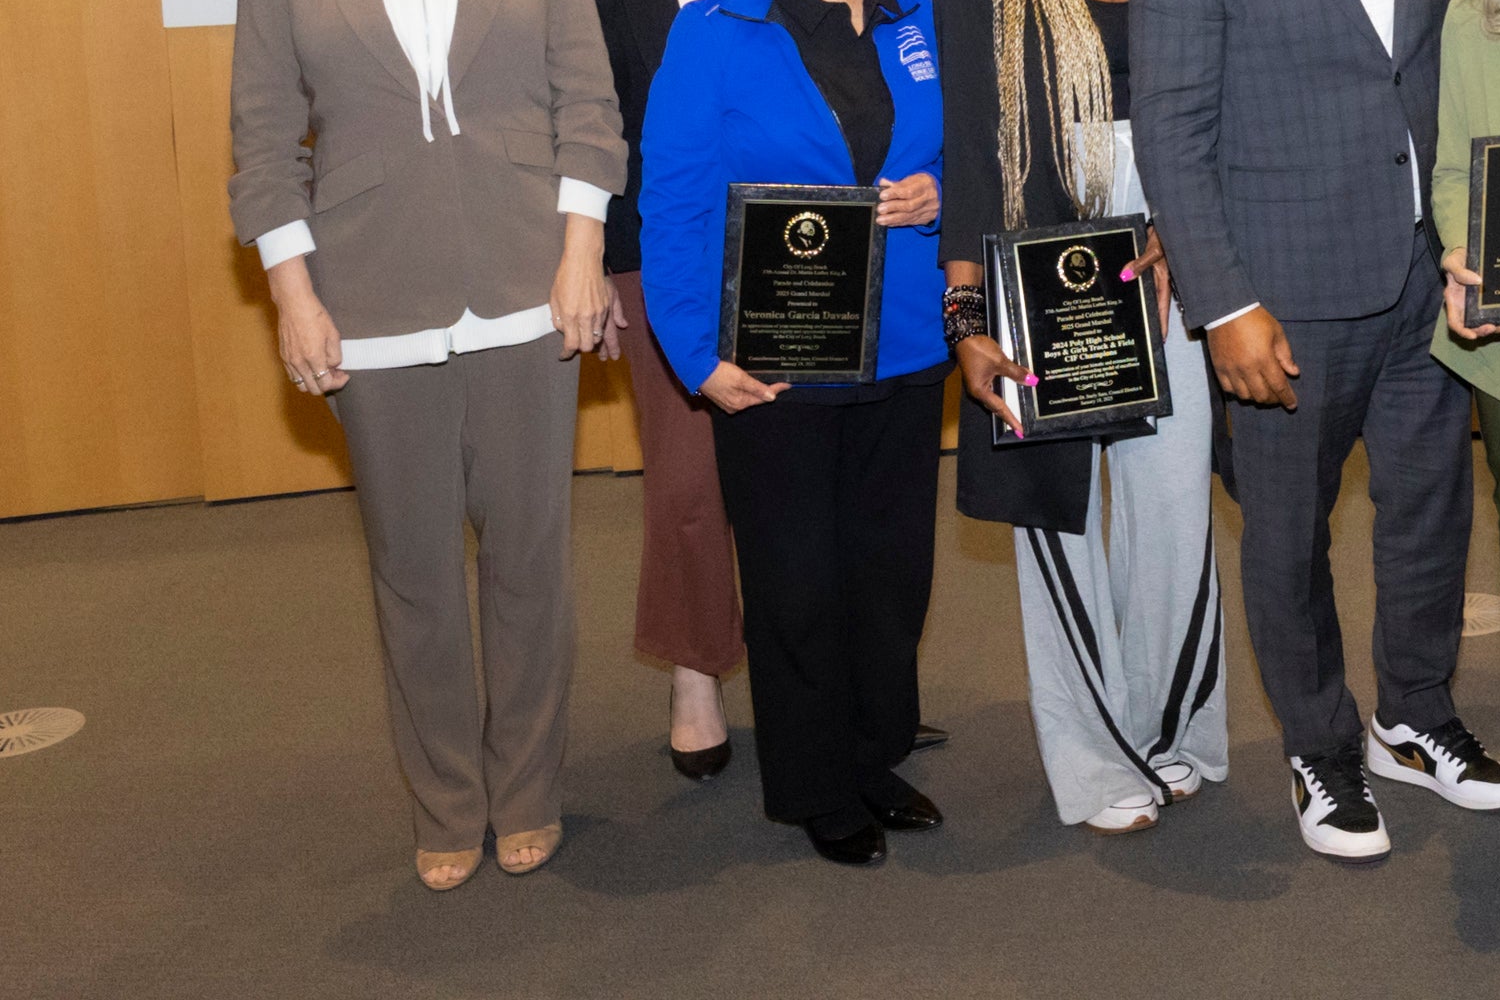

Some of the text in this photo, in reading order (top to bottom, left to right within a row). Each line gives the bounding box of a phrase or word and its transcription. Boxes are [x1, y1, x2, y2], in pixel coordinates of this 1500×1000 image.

[744, 310, 785, 319] Veronica
[823, 311, 859, 320] Davalos
[1052, 333, 1125, 350] 2024 Poly High School
[1070, 346, 1088, 354] Girls
[1089, 343, 1109, 351] Track
[1118, 339, 1135, 347] Field
[1079, 350, 1117, 360] Champions
